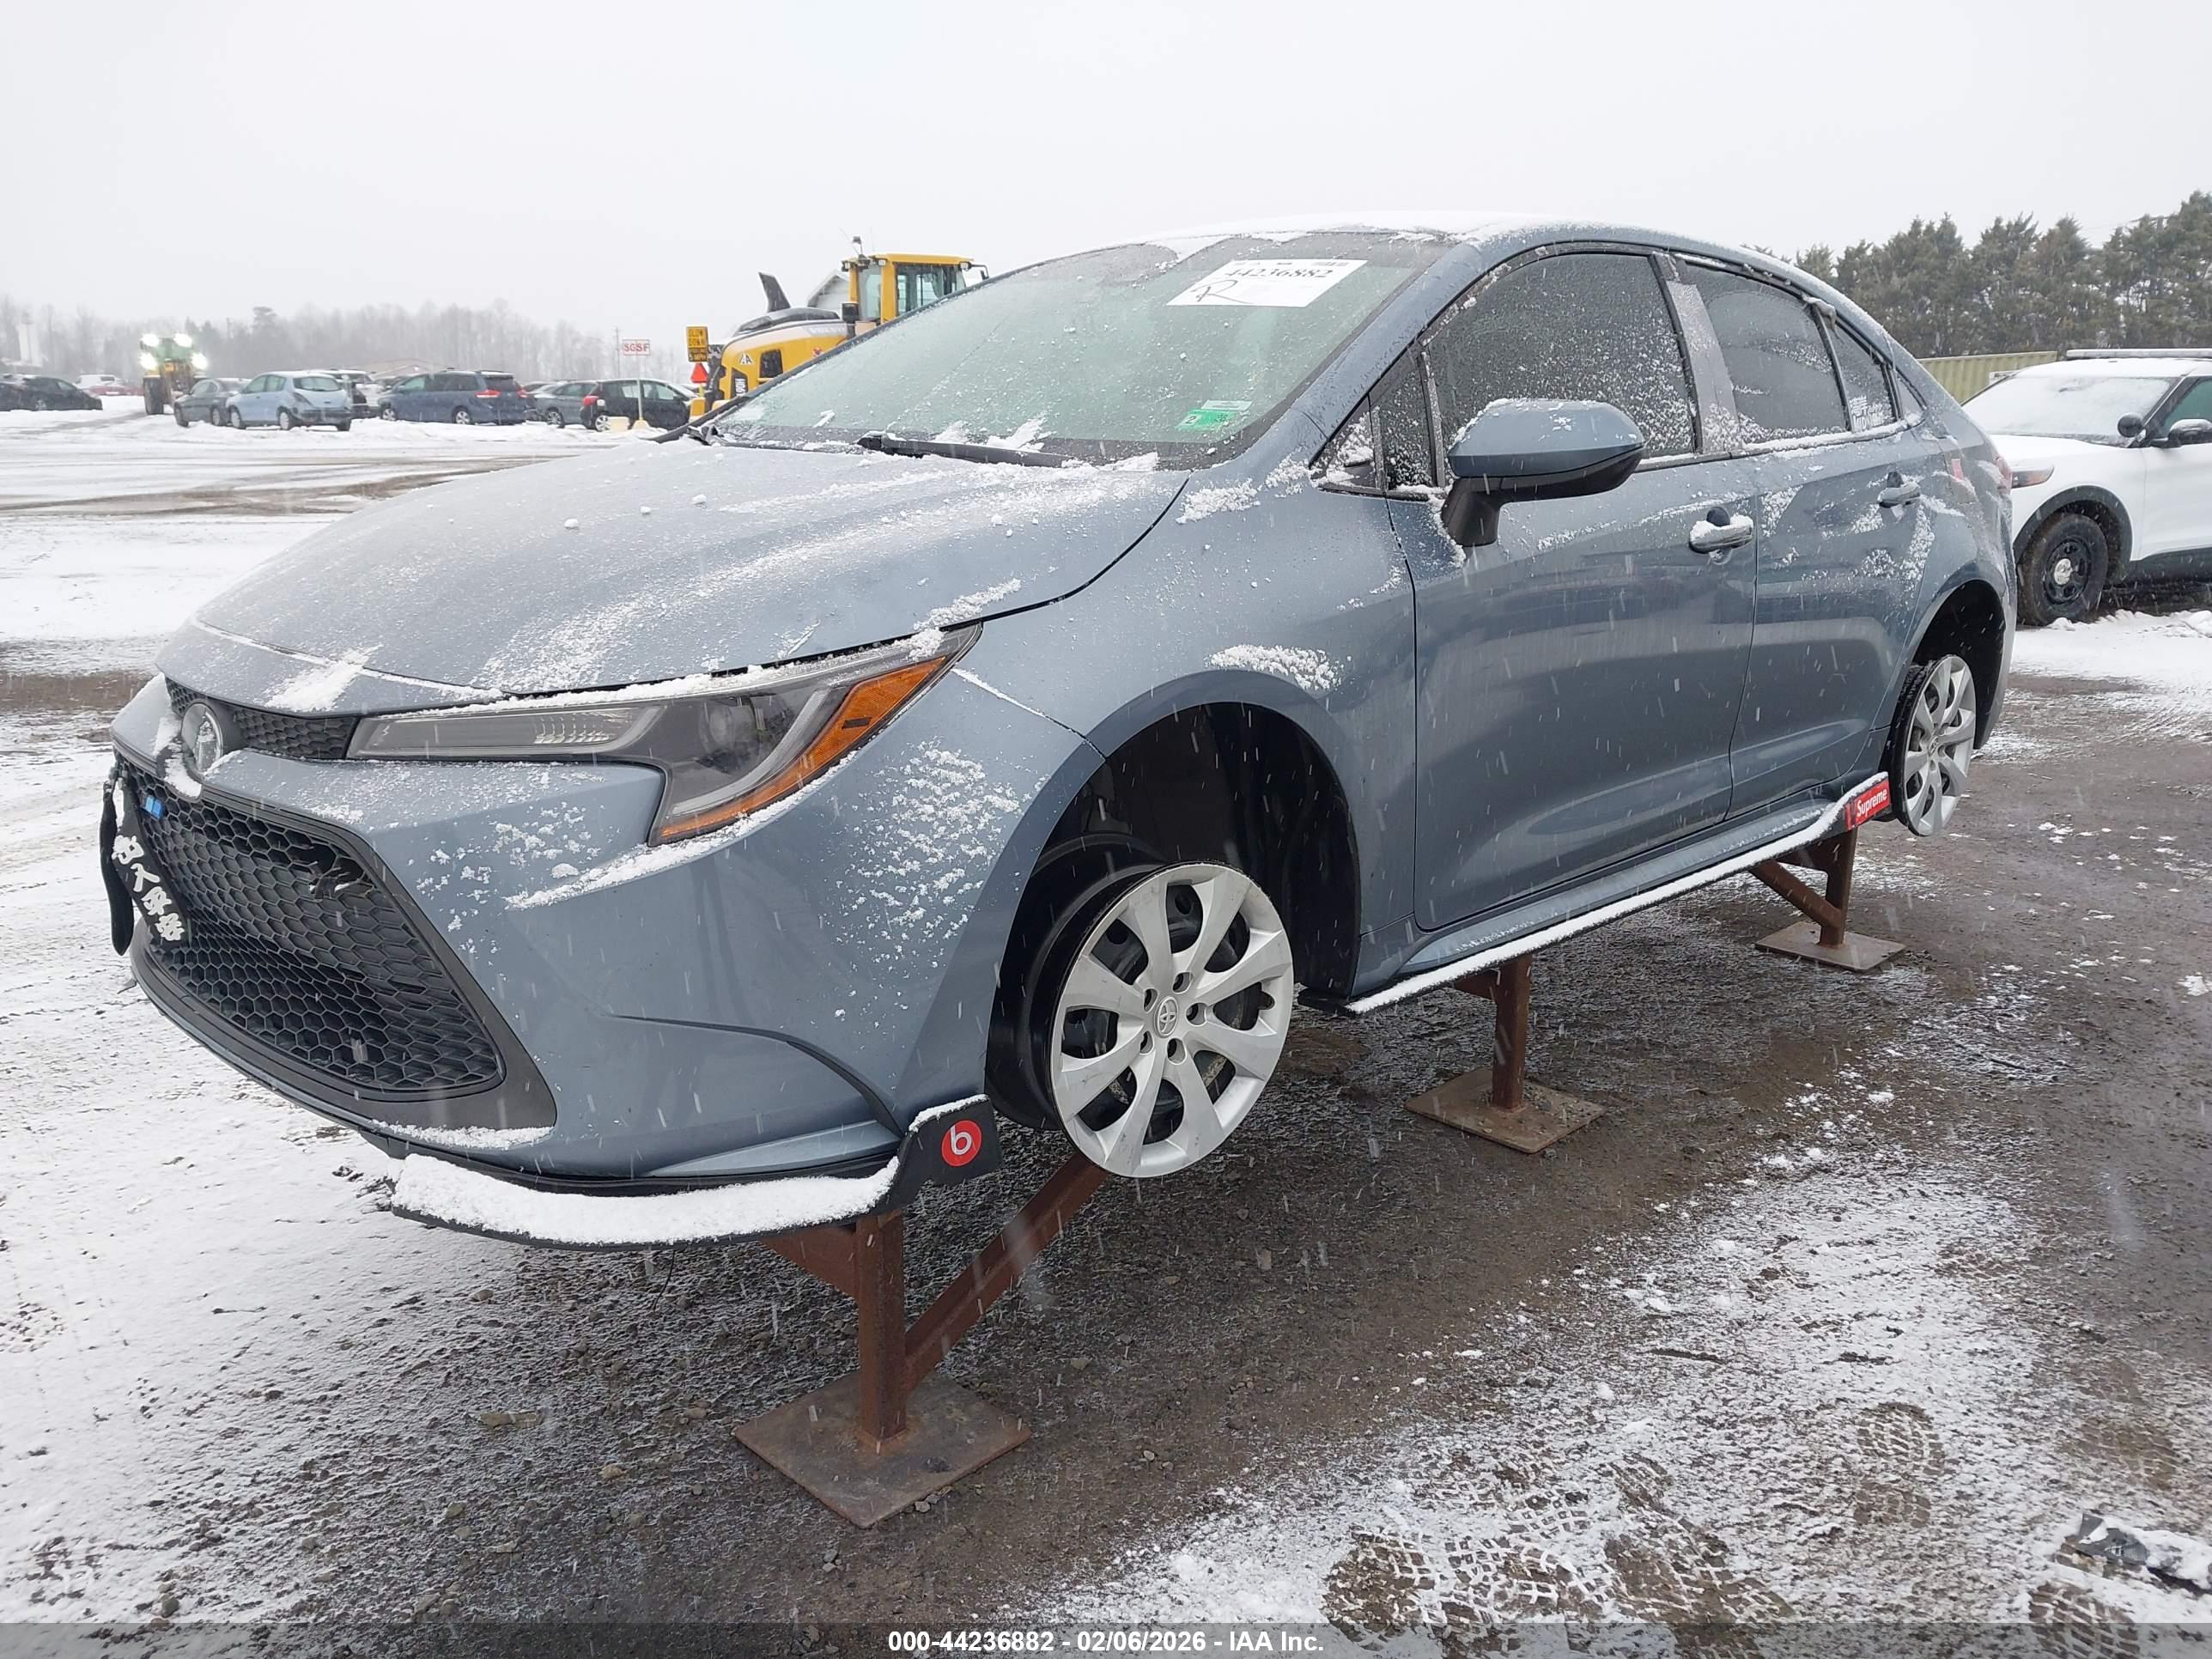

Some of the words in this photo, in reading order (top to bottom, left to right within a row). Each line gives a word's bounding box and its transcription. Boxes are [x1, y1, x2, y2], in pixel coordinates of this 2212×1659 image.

[623, 343, 650, 352] SGSF
[1185, 416, 1197, 424] 2
[1856, 788, 1887, 817] Supreme
